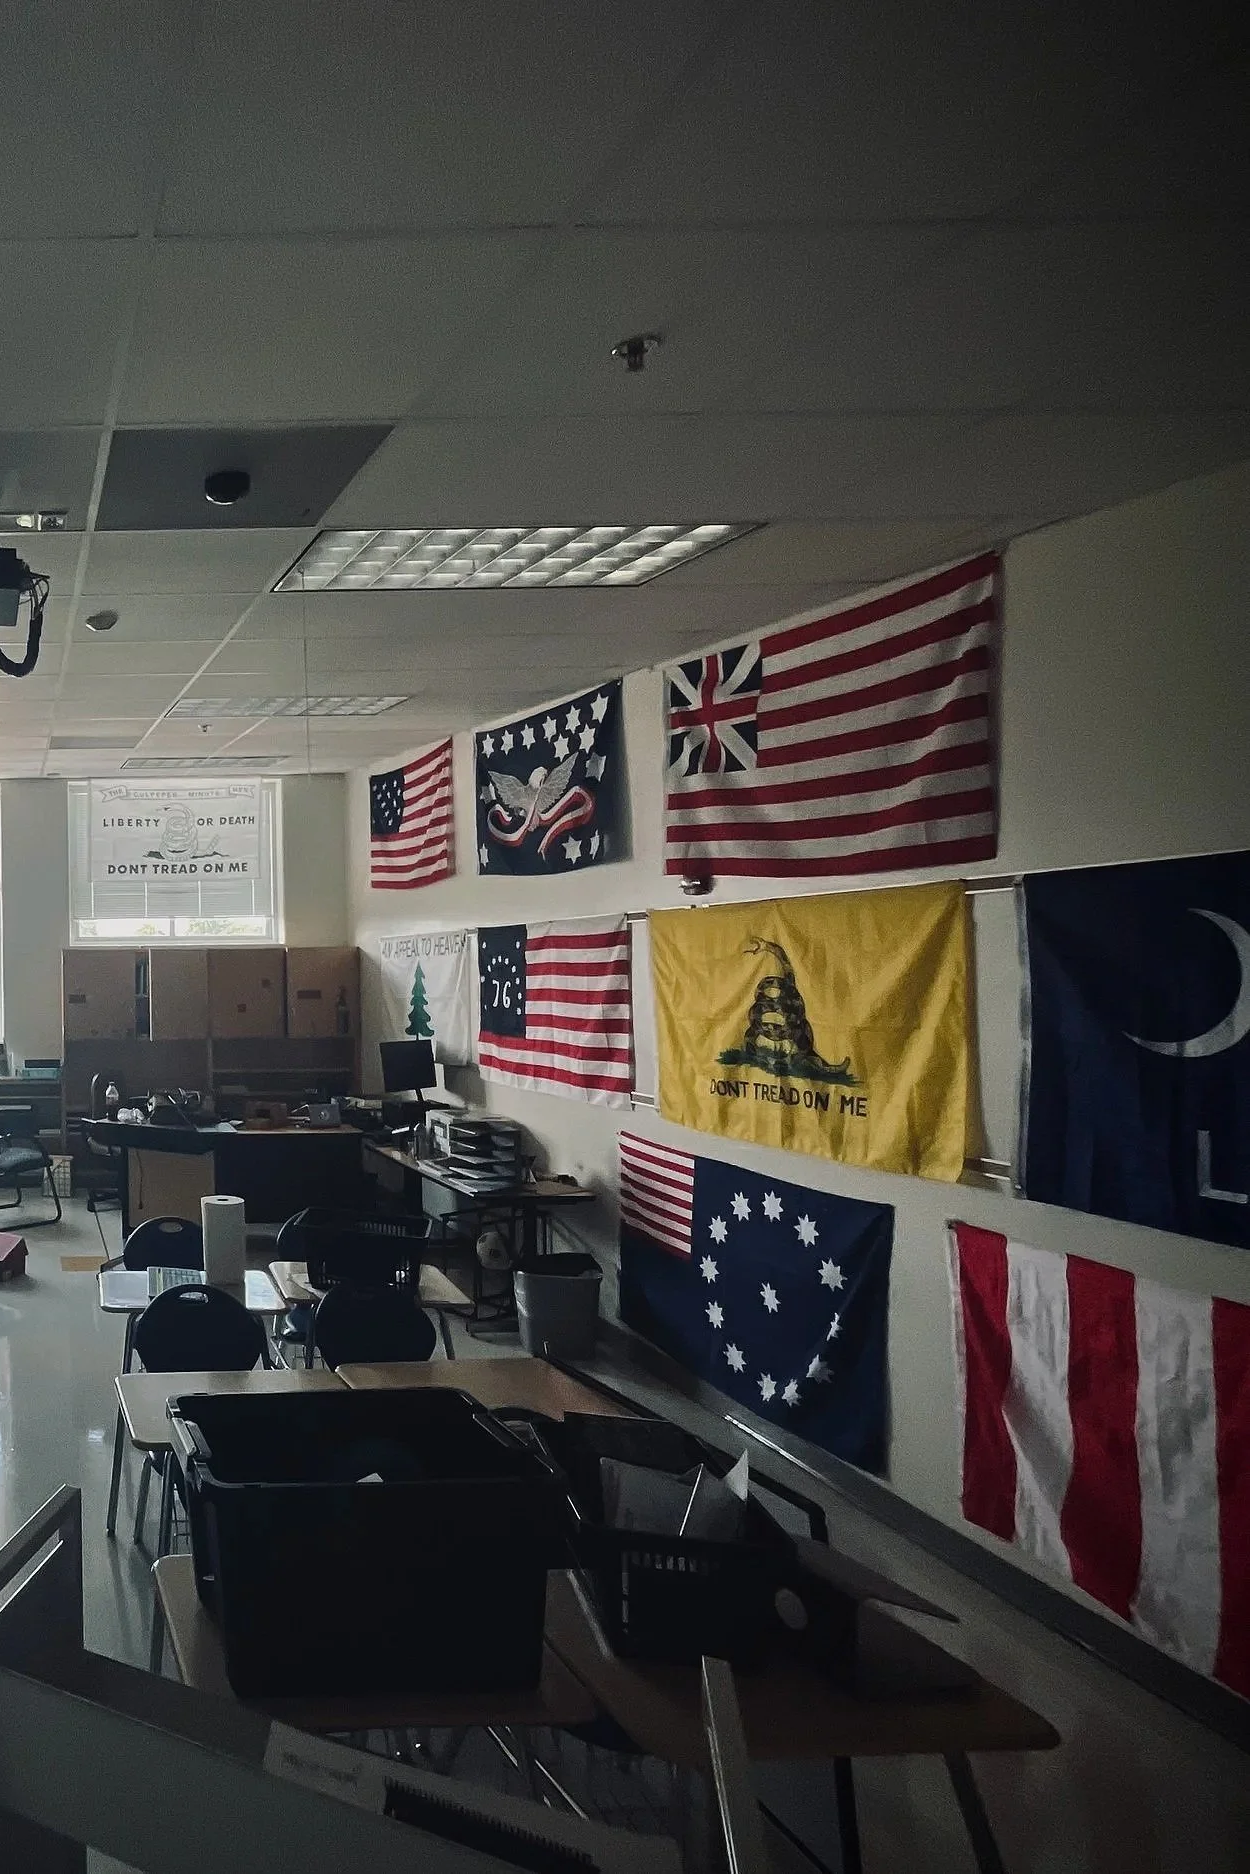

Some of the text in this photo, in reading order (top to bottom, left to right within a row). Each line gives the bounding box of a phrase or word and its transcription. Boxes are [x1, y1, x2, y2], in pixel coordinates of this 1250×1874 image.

[103, 816, 255, 827] LIBERTY OR DEATH
[107, 862, 249, 875] DONT TREAD ON ME
[421, 937, 432, 957] TO
[492, 979, 511, 1008] 76
[710, 1079, 868, 1117] DONT TREAD ON ME
